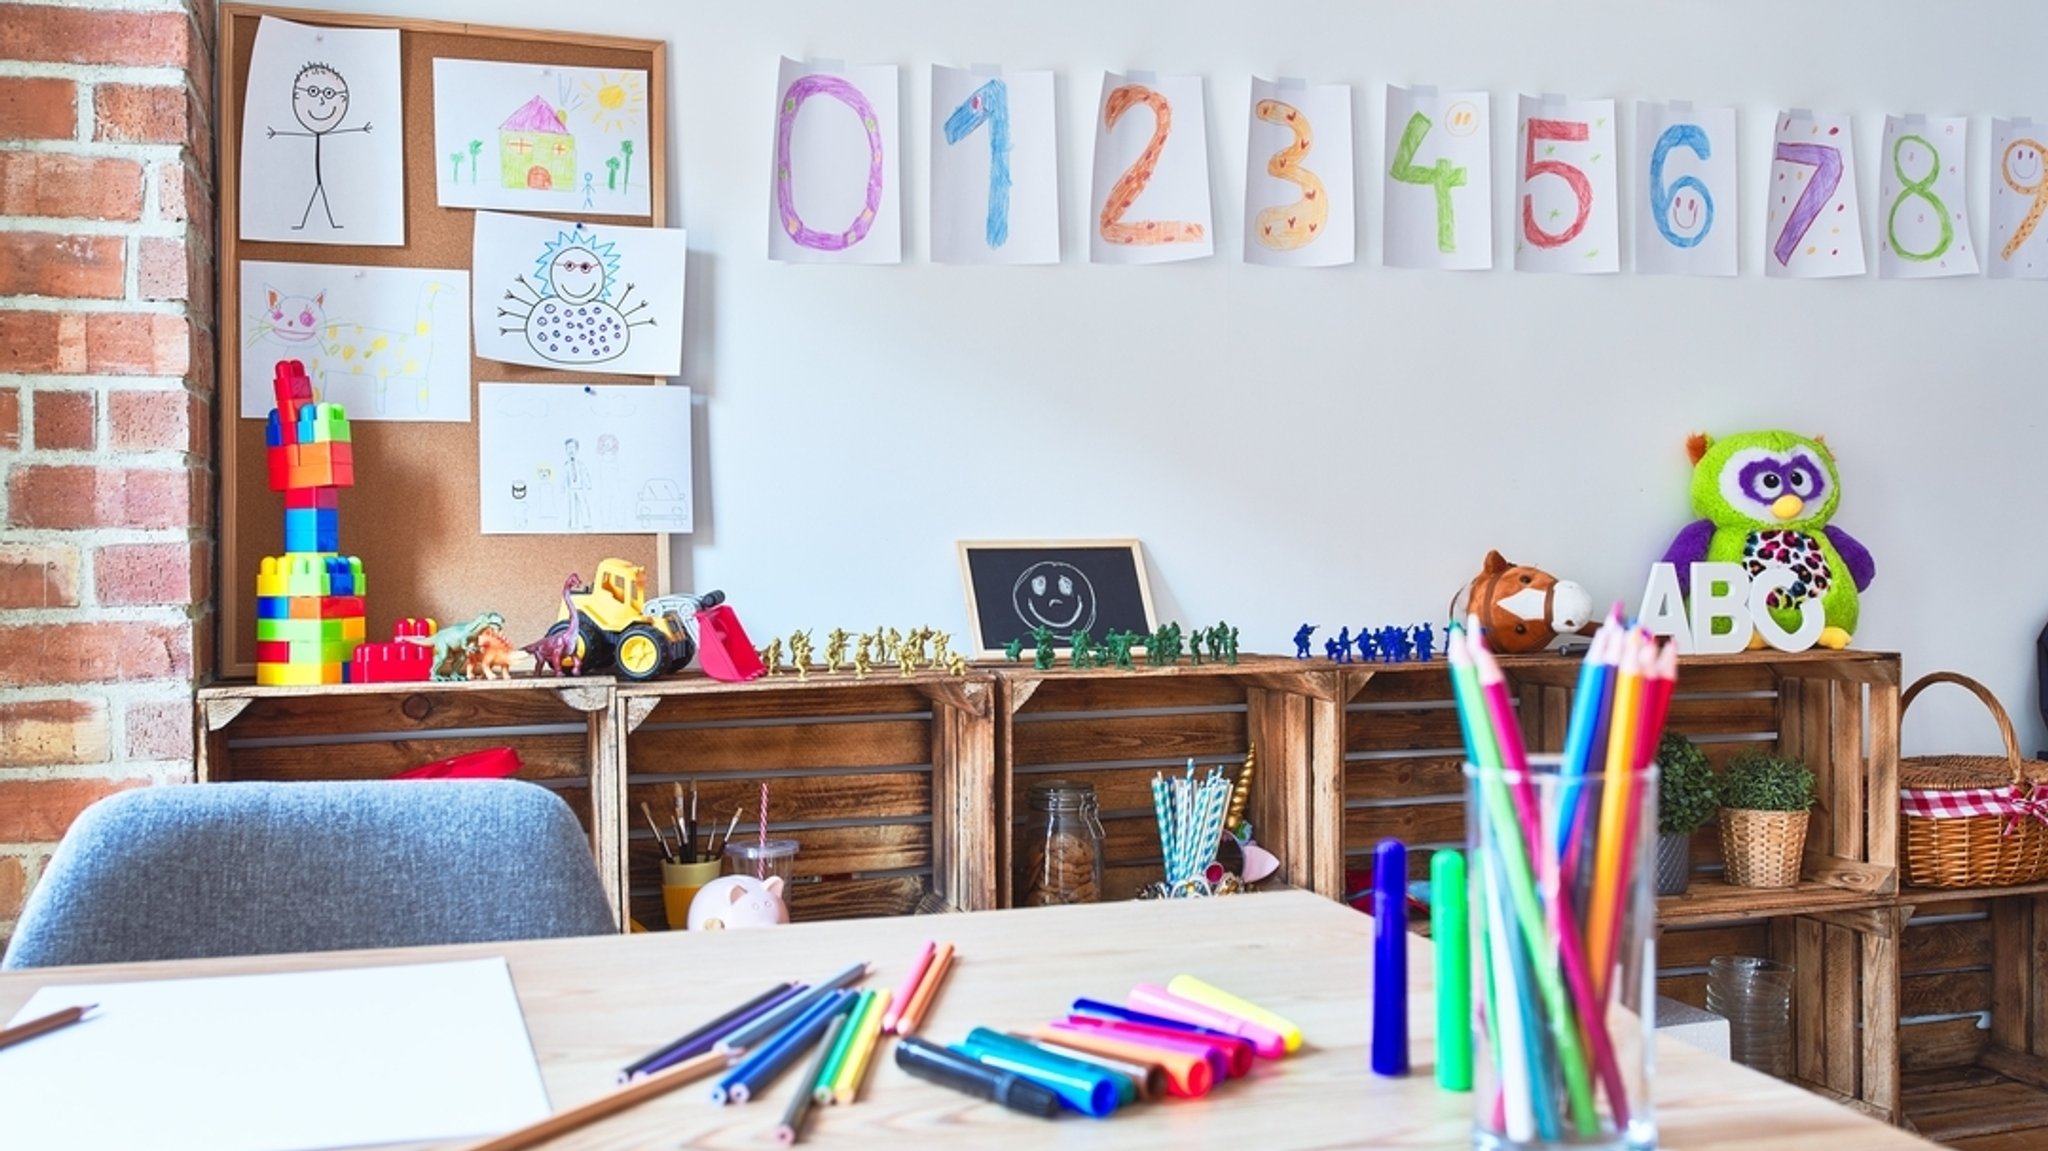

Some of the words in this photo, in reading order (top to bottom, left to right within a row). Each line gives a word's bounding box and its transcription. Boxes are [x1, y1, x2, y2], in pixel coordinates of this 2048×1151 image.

[778, 75, 883, 250] 0
[943, 79, 1014, 249] 1
[1100, 84, 1205, 246] 2
[1255, 99, 1328, 249] 3
[1389, 110, 1467, 253] 4
[1522, 117, 1593, 247] 5
[1650, 123, 1715, 247] 6
[1774, 142, 1844, 266] 7
[1888, 135, 1954, 262] 8
[2001, 138, 2048, 261] 9
[1637, 561, 1825, 655] ABC
